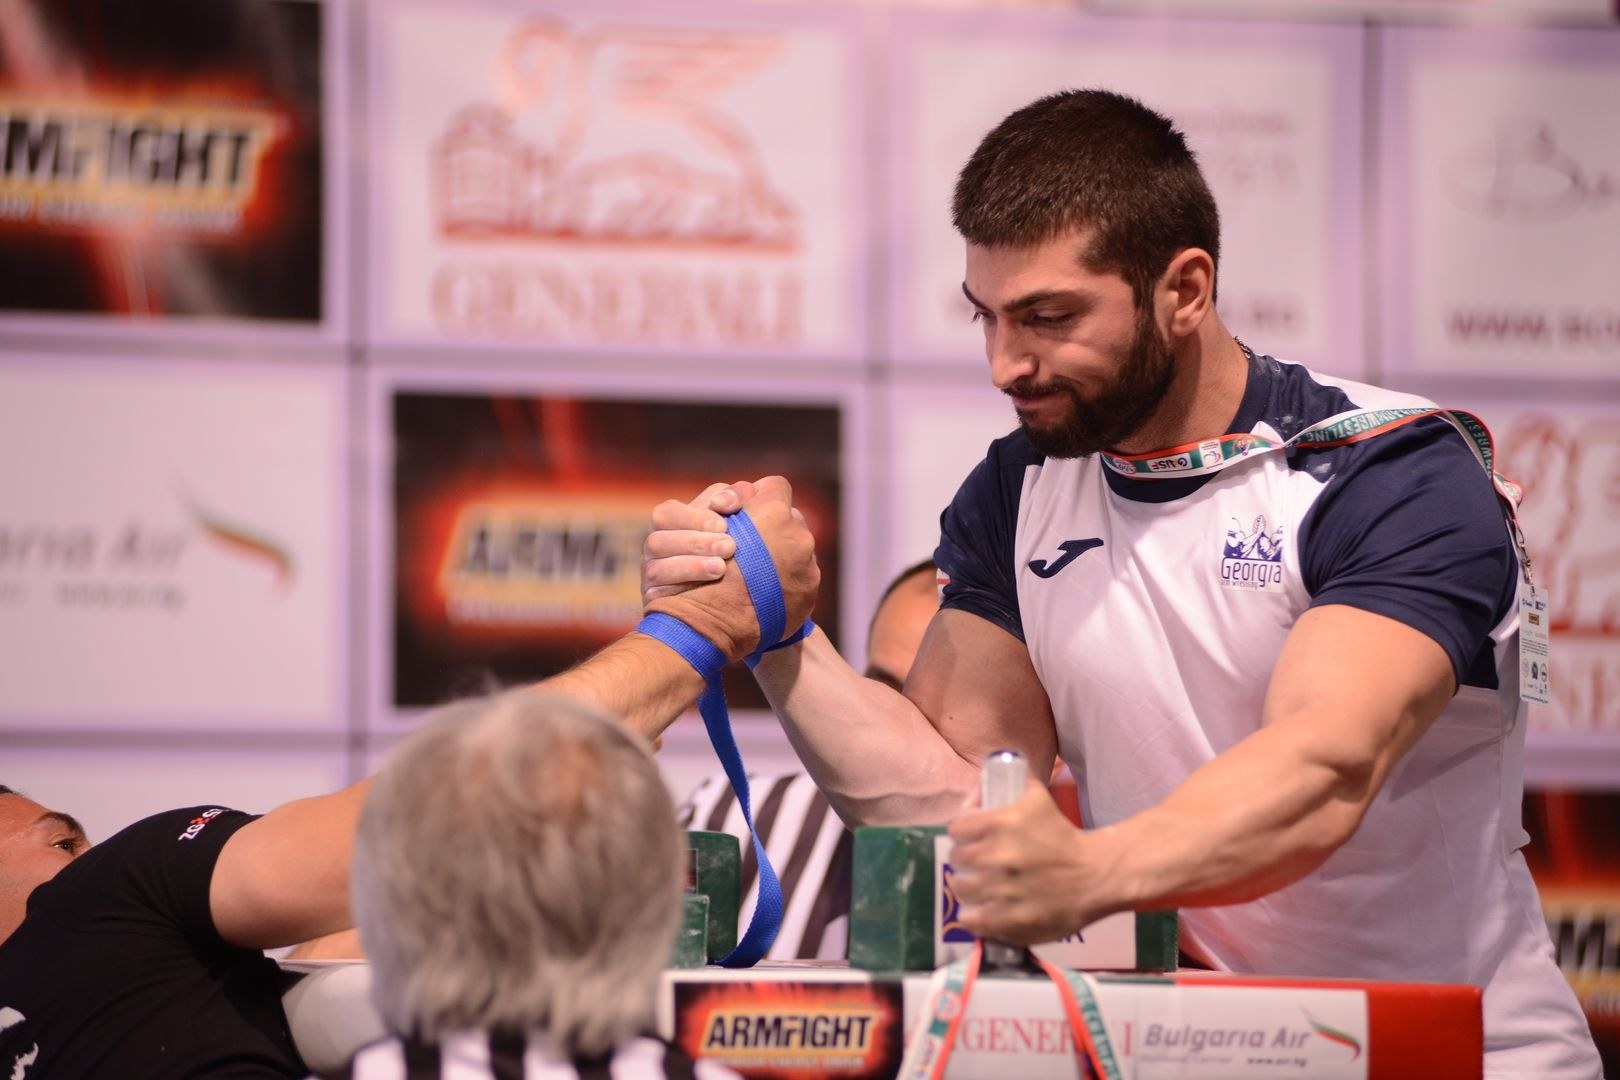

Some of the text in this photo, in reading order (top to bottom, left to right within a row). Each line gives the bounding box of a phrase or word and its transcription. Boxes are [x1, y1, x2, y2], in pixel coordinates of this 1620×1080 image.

[1221, 560, 1282, 587] Georgia
[707, 1014, 872, 1049] ARMFIGHT
[1144, 1024, 1311, 1051] Bulgaria Air
